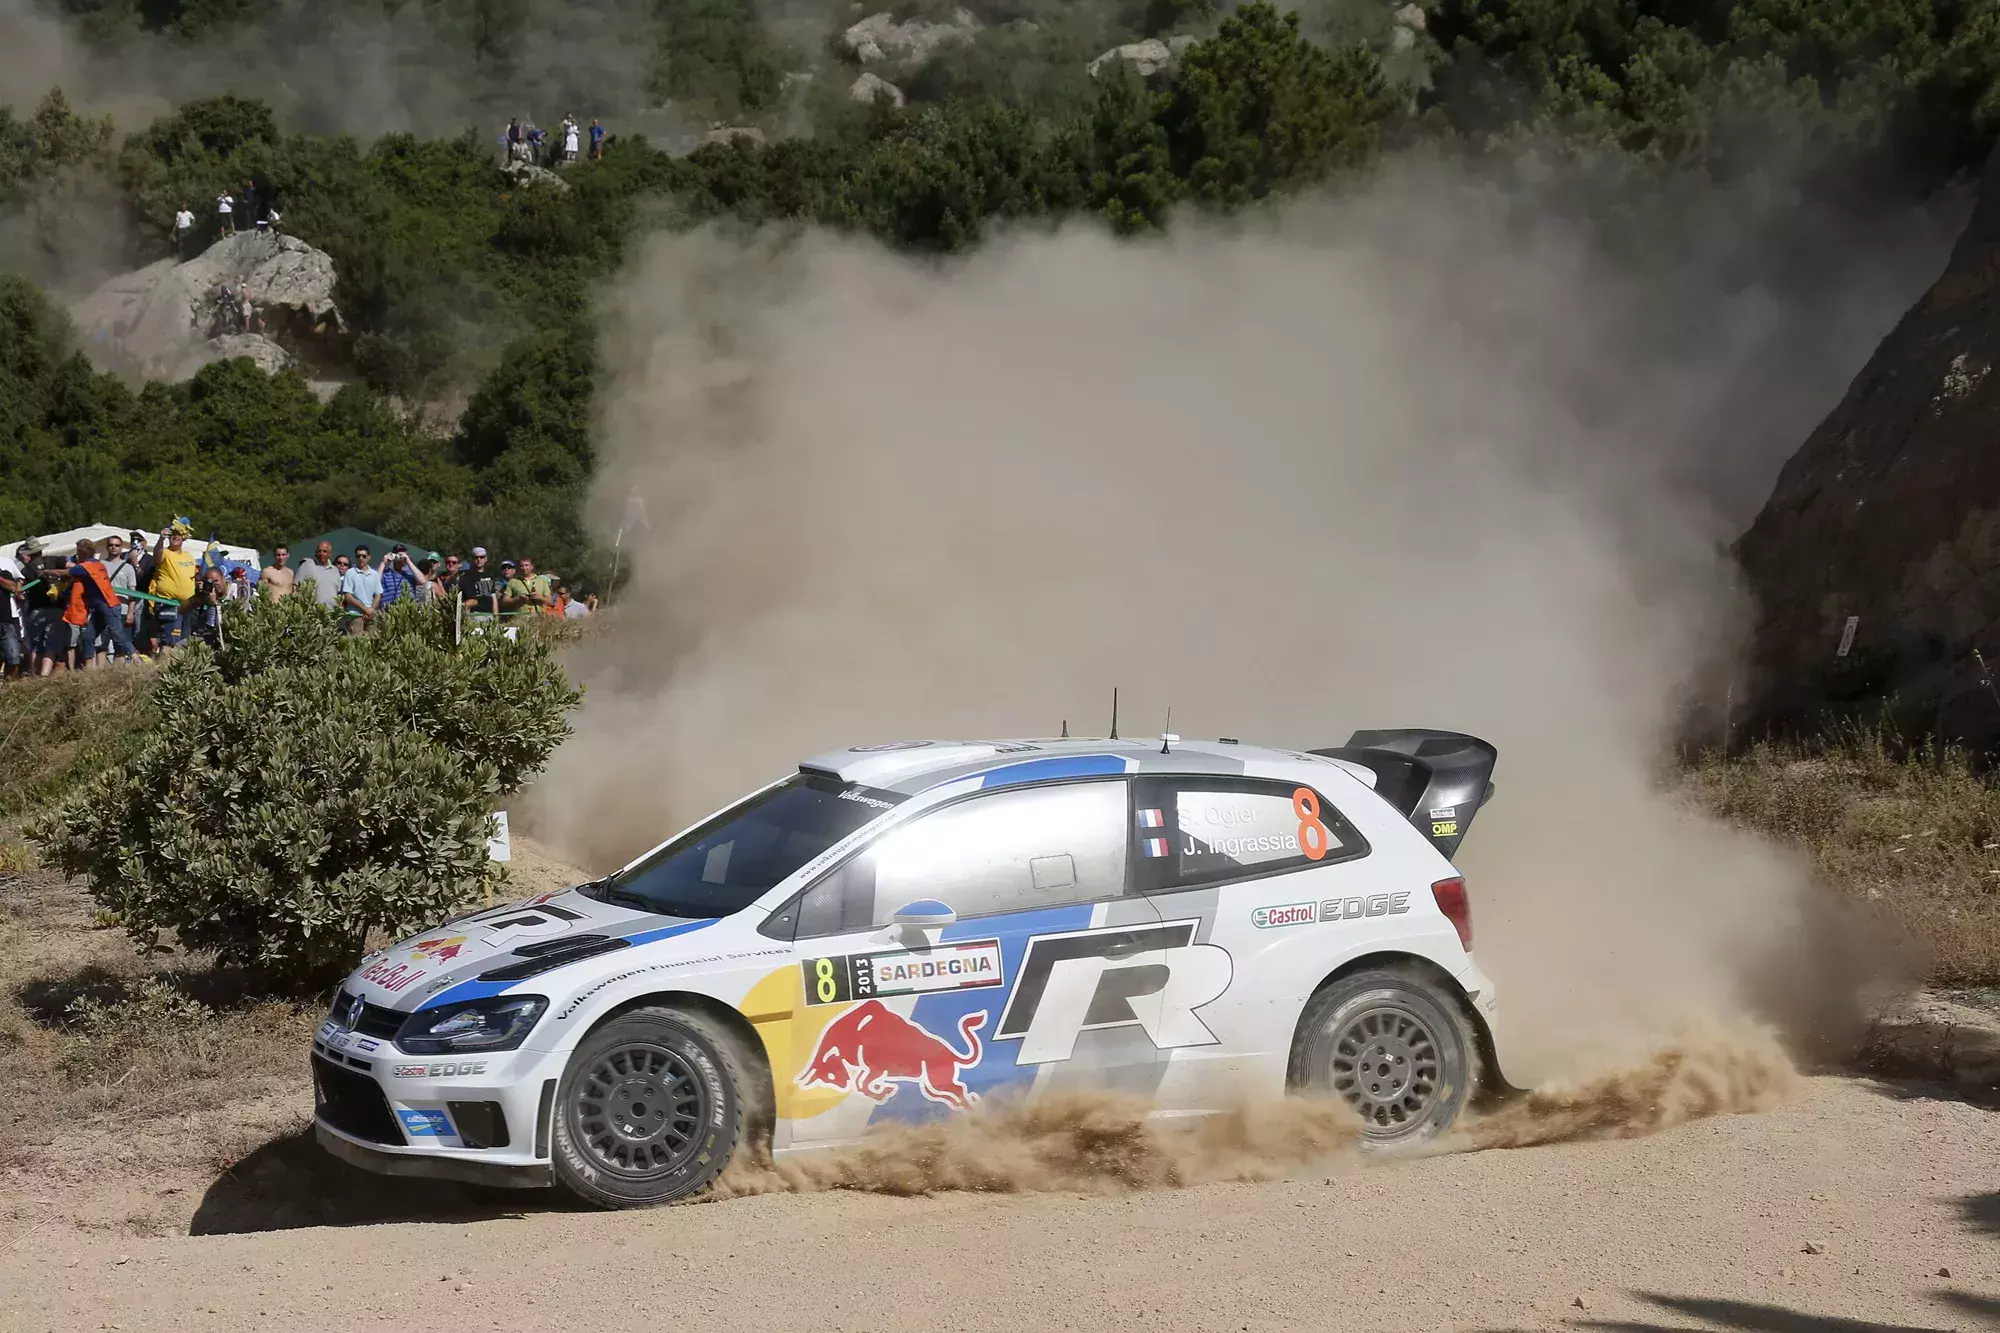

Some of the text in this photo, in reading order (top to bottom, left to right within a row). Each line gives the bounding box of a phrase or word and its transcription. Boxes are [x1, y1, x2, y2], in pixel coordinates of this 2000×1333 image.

[838, 789, 895, 809] Volkswagen
[1205, 806, 1258, 828] Ogier
[1292, 787, 1328, 860] 8
[1432, 823, 1457, 835] OMP
[799, 812, 898, 880] www.volkswagen-motorsport.com
[1183, 831, 1298, 857] J. Ingrassia
[1268, 891, 1411, 926] Castrol EDGE
[556, 947, 793, 1020] Volkswagen Financial Services
[815, 957, 837, 1003] 8
[856, 958, 871, 995] 2013
[879, 956, 992, 982] SARDEGNA
[1016, 943, 1234, 1066] R
[428, 1060, 488, 1077] EDGE
[406, 1114, 444, 1123] ultimate
